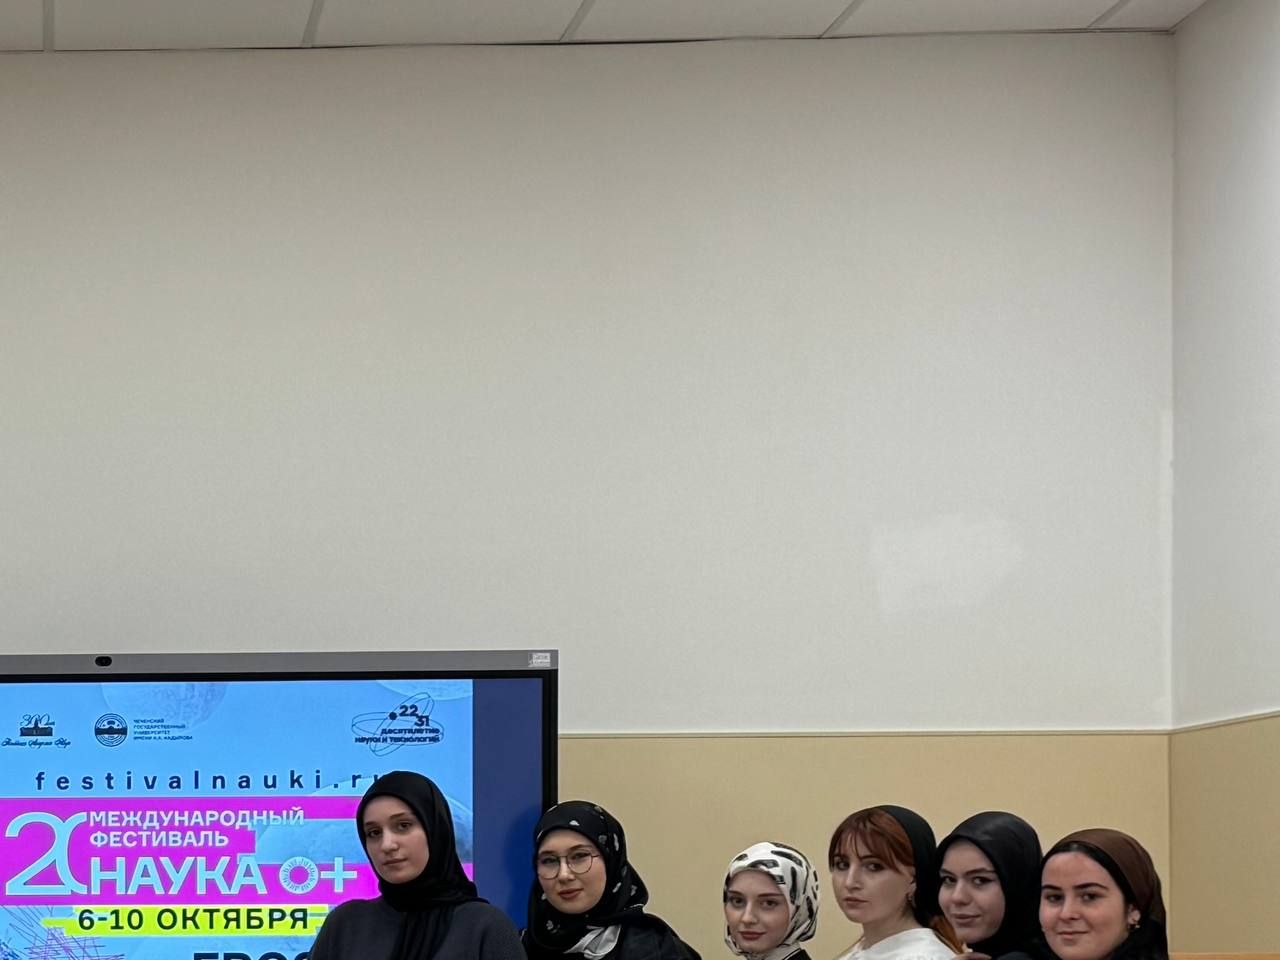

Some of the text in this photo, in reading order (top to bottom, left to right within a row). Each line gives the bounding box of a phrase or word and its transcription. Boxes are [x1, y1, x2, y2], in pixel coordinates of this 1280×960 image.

[89, 806, 305, 829] МЕЖДУНАРОДНЫЙ
[89, 830, 229, 848] ФЕСТИВАЛЬ
[91, 856, 268, 895] НАУКА
[77, 907, 309, 931] 6-10 ОКТЯБРЯ
